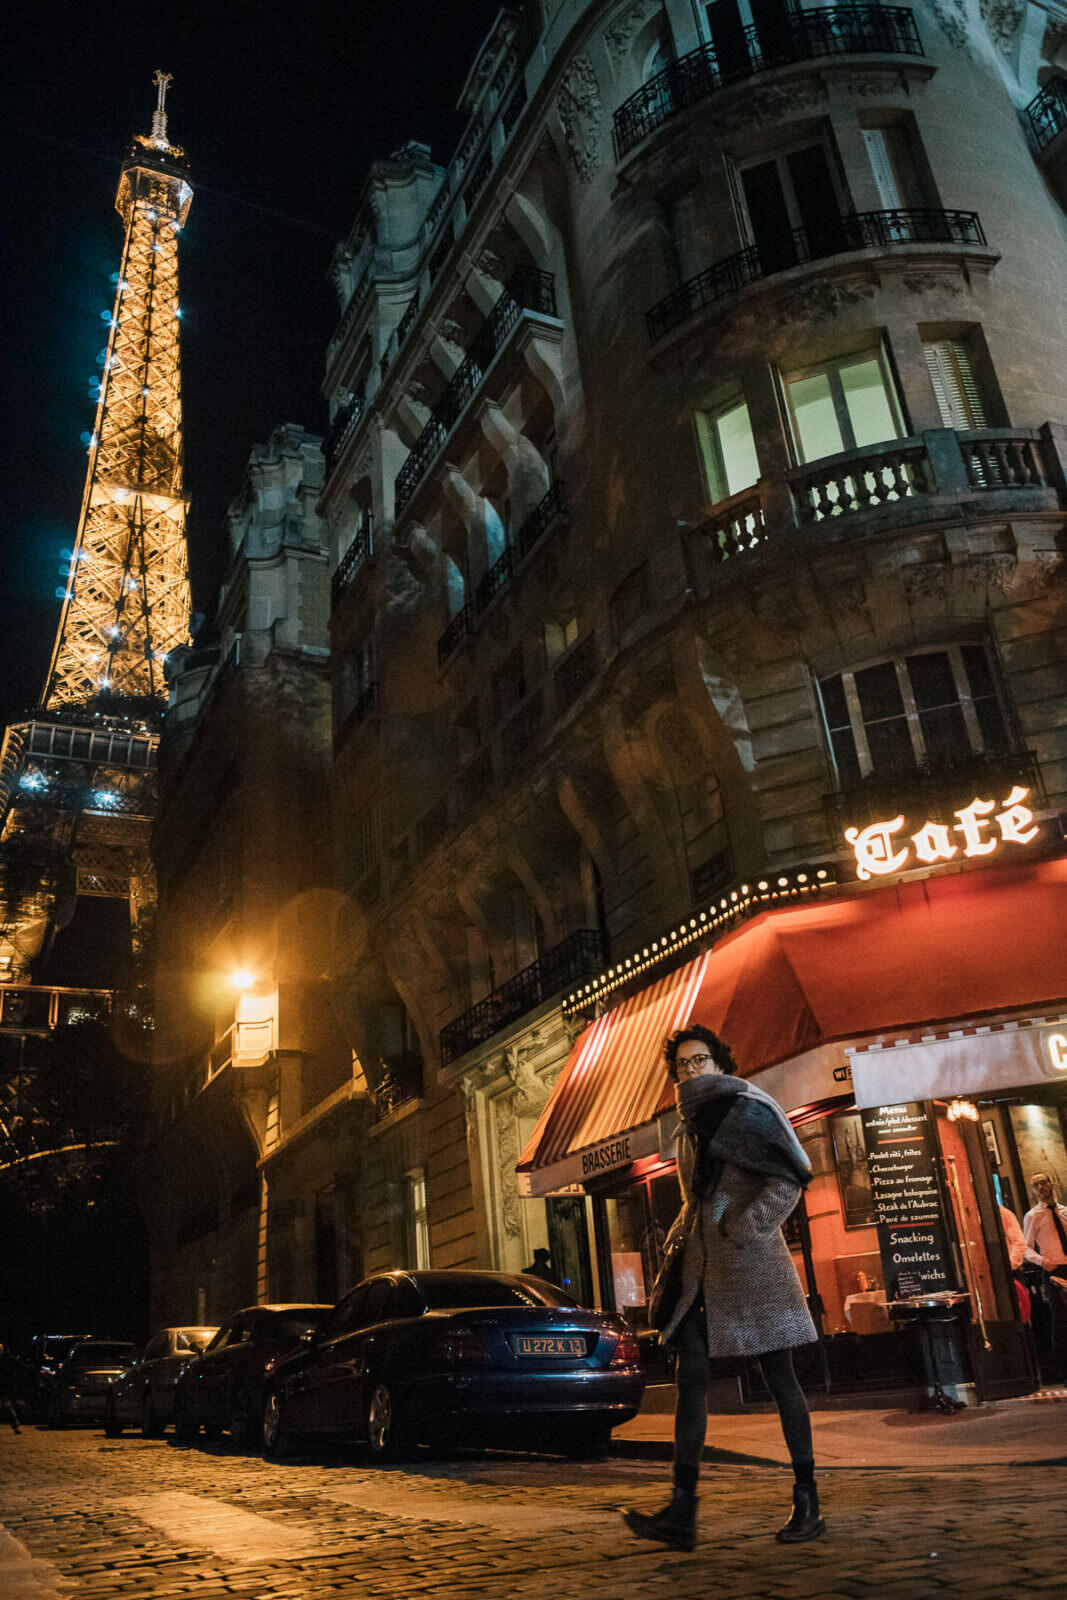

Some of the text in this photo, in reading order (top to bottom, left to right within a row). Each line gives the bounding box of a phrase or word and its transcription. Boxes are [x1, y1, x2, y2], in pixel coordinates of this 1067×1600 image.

[844, 785, 1041, 881] Café
[582, 1137, 631, 1175] BRASSERIE
[874, 1177, 894, 1186] Pizza
[905, 1175, 933, 1184] fromage
[878, 1202, 898, 1211] Steak
[889, 1231, 935, 1246] Snacking
[892, 1251, 941, 1263] Omelettes
[918, 1268, 946, 1280] wichs
